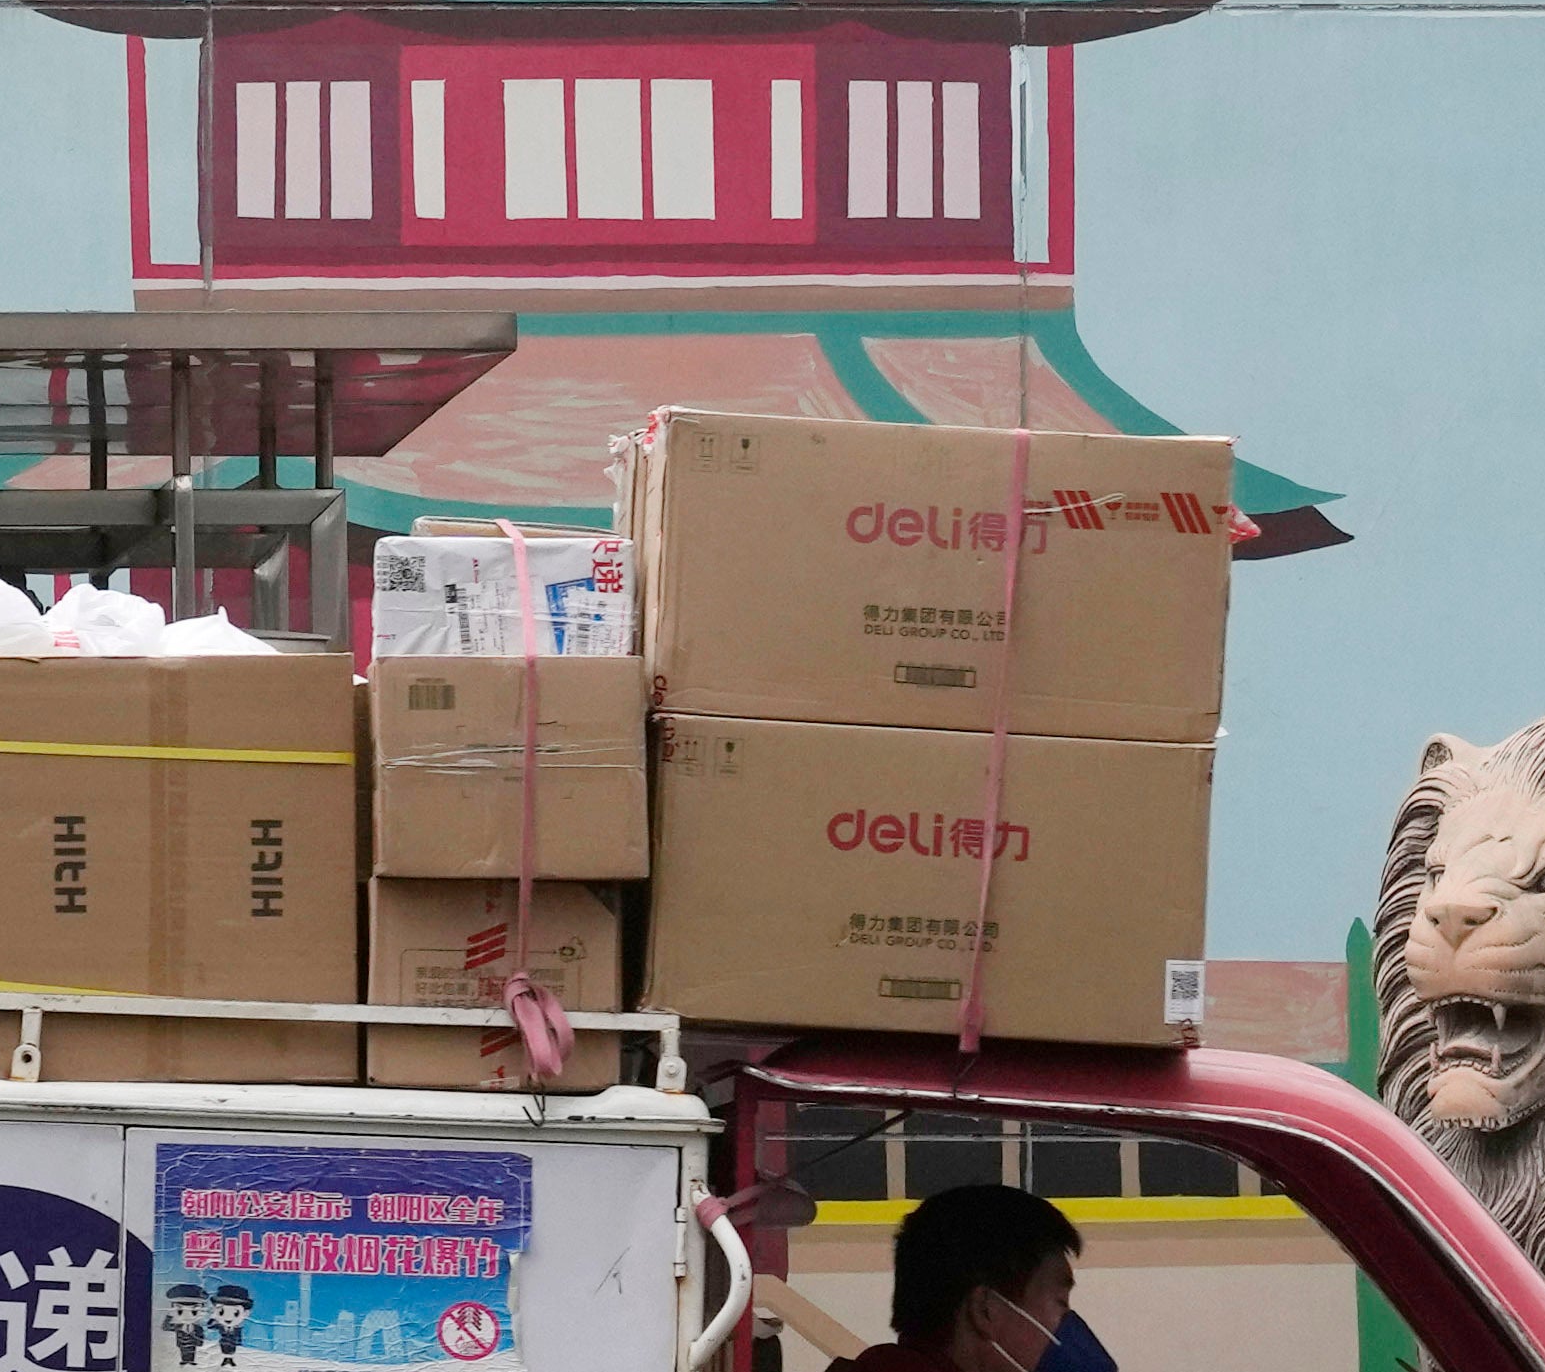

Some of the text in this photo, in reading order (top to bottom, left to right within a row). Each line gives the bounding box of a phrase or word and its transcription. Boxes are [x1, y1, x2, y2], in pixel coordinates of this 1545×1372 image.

[849, 913, 1000, 938] 得力集团有限公司
[183, 1229, 501, 1279] 禁止燃放烟花爆竹
